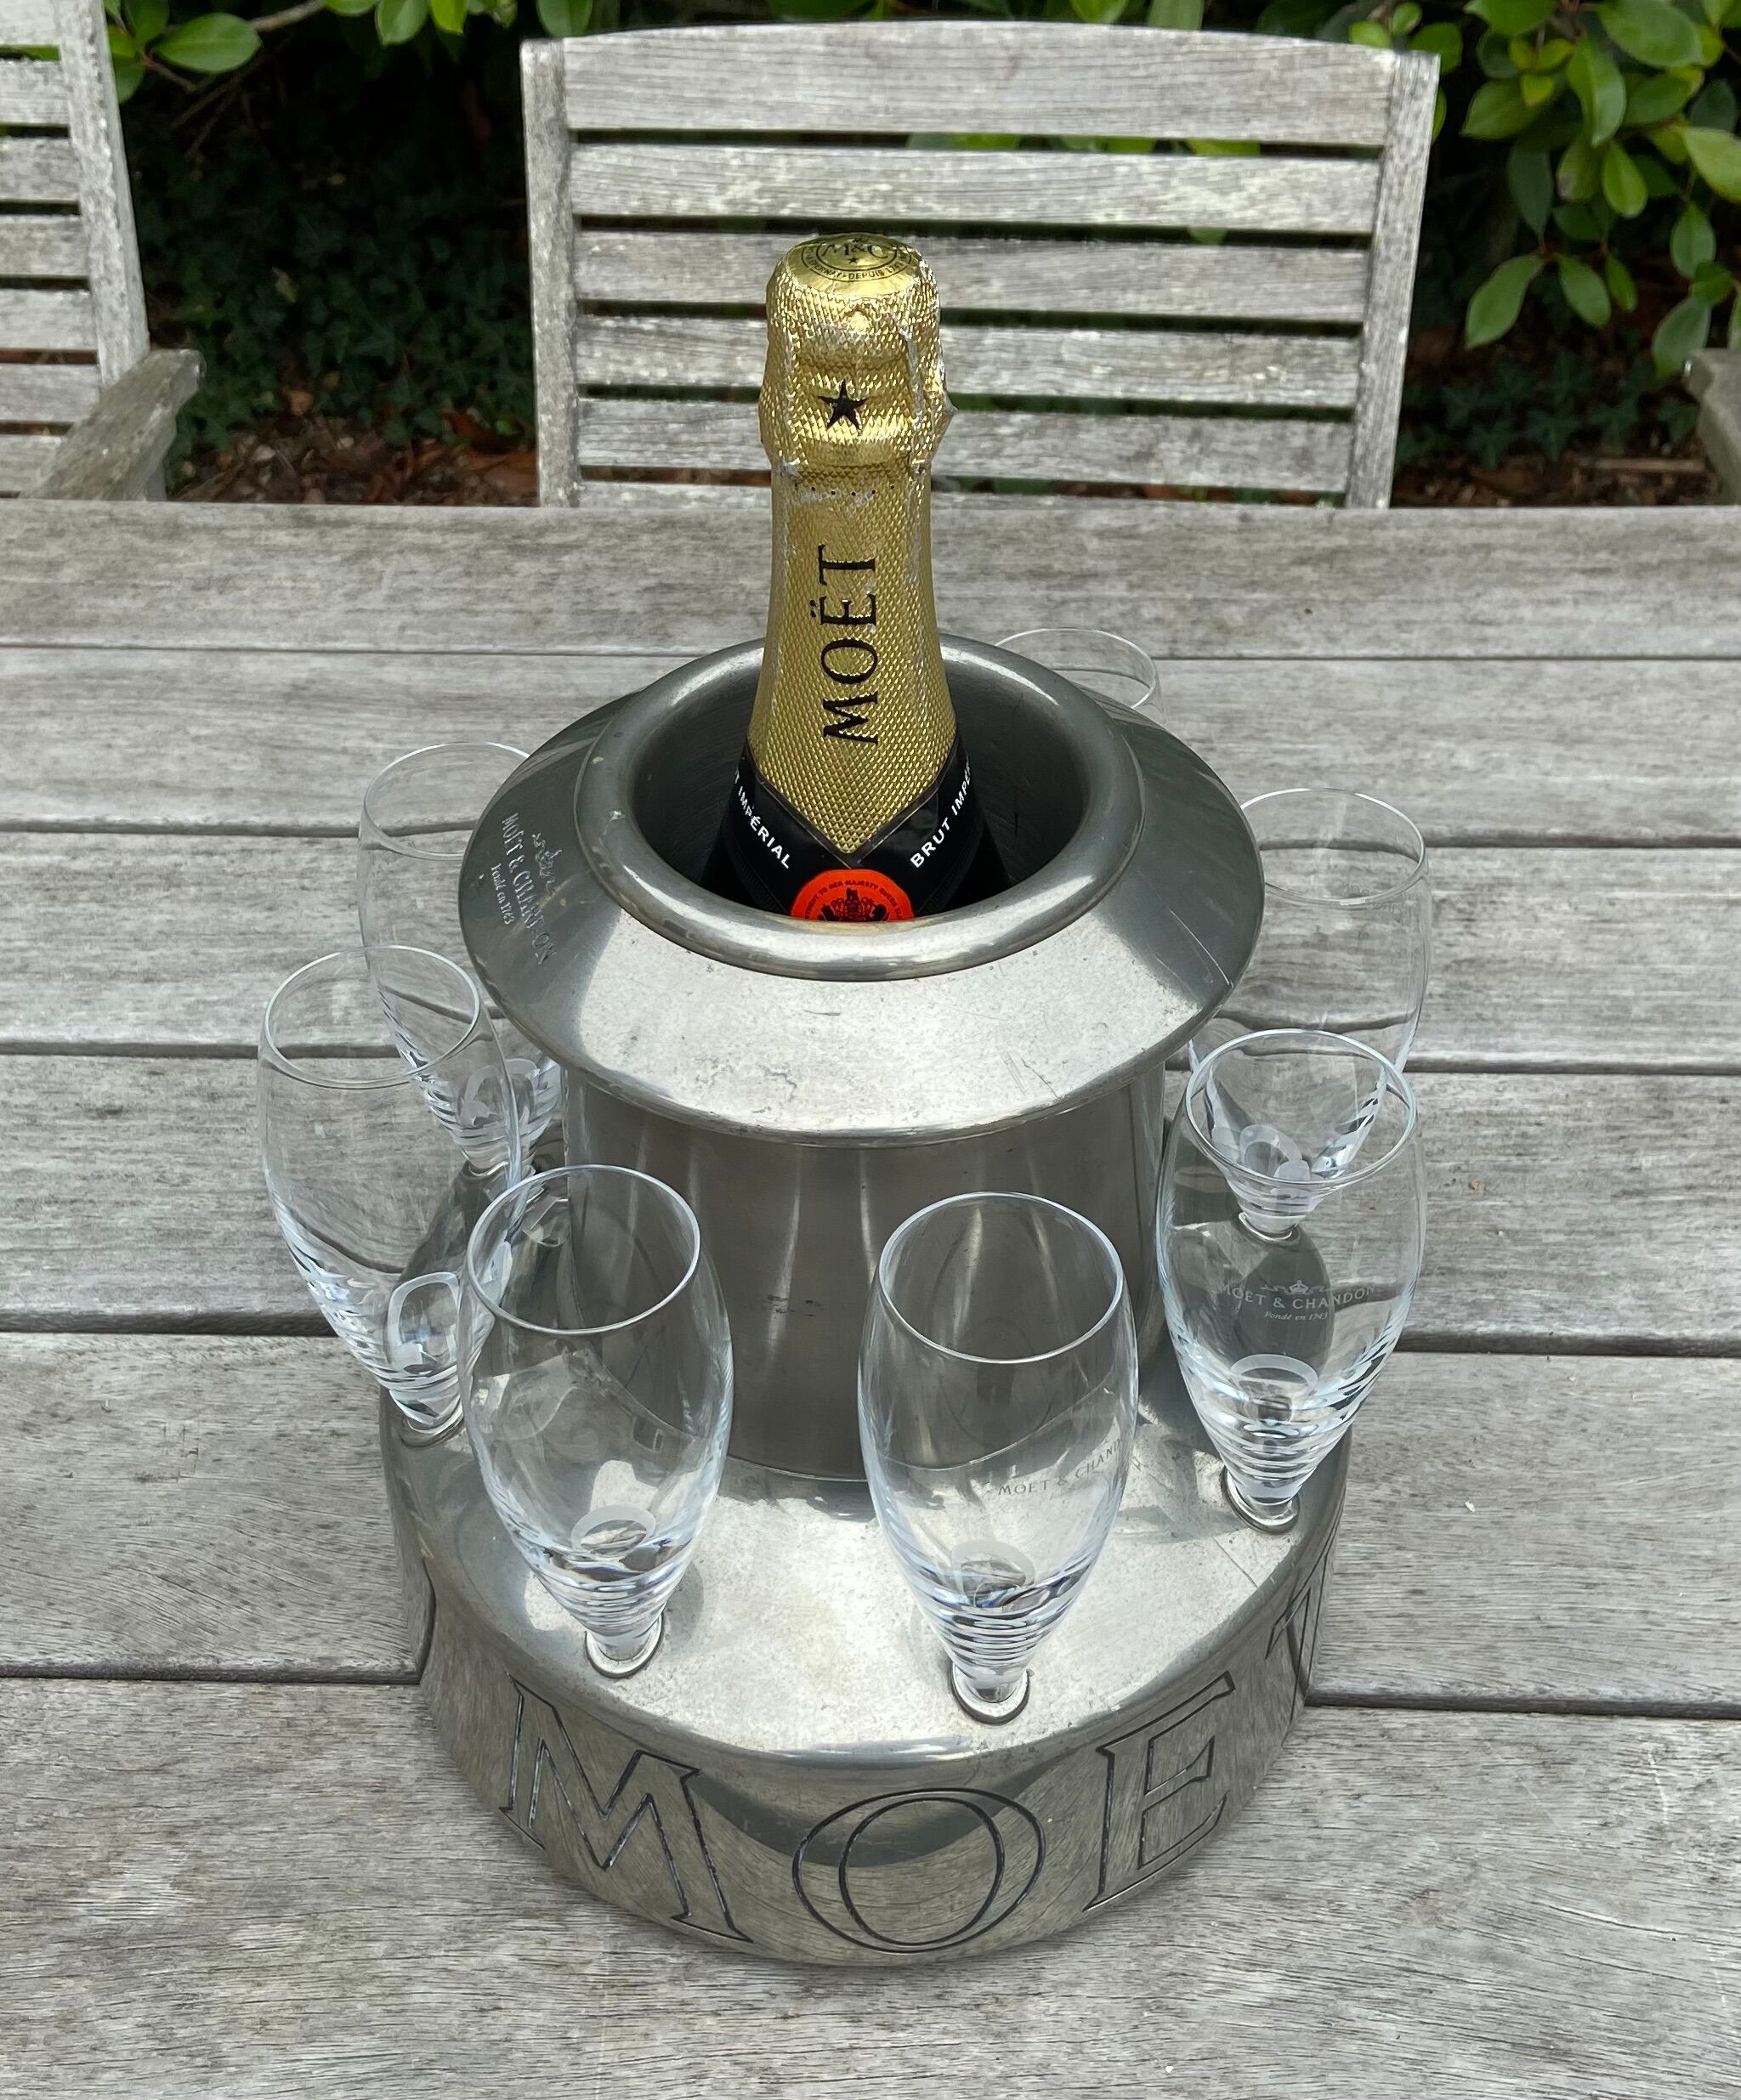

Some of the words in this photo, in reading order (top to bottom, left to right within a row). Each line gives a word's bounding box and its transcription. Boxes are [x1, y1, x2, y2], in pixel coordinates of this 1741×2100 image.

[809, 543, 878, 746] MOËT
[738, 785, 791, 869] IMPÉRIAL
[910, 817, 950, 868] BRUT
[1273, 1297, 1286, 1310] &
[1291, 1285, 1375, 1310] CHANDON
